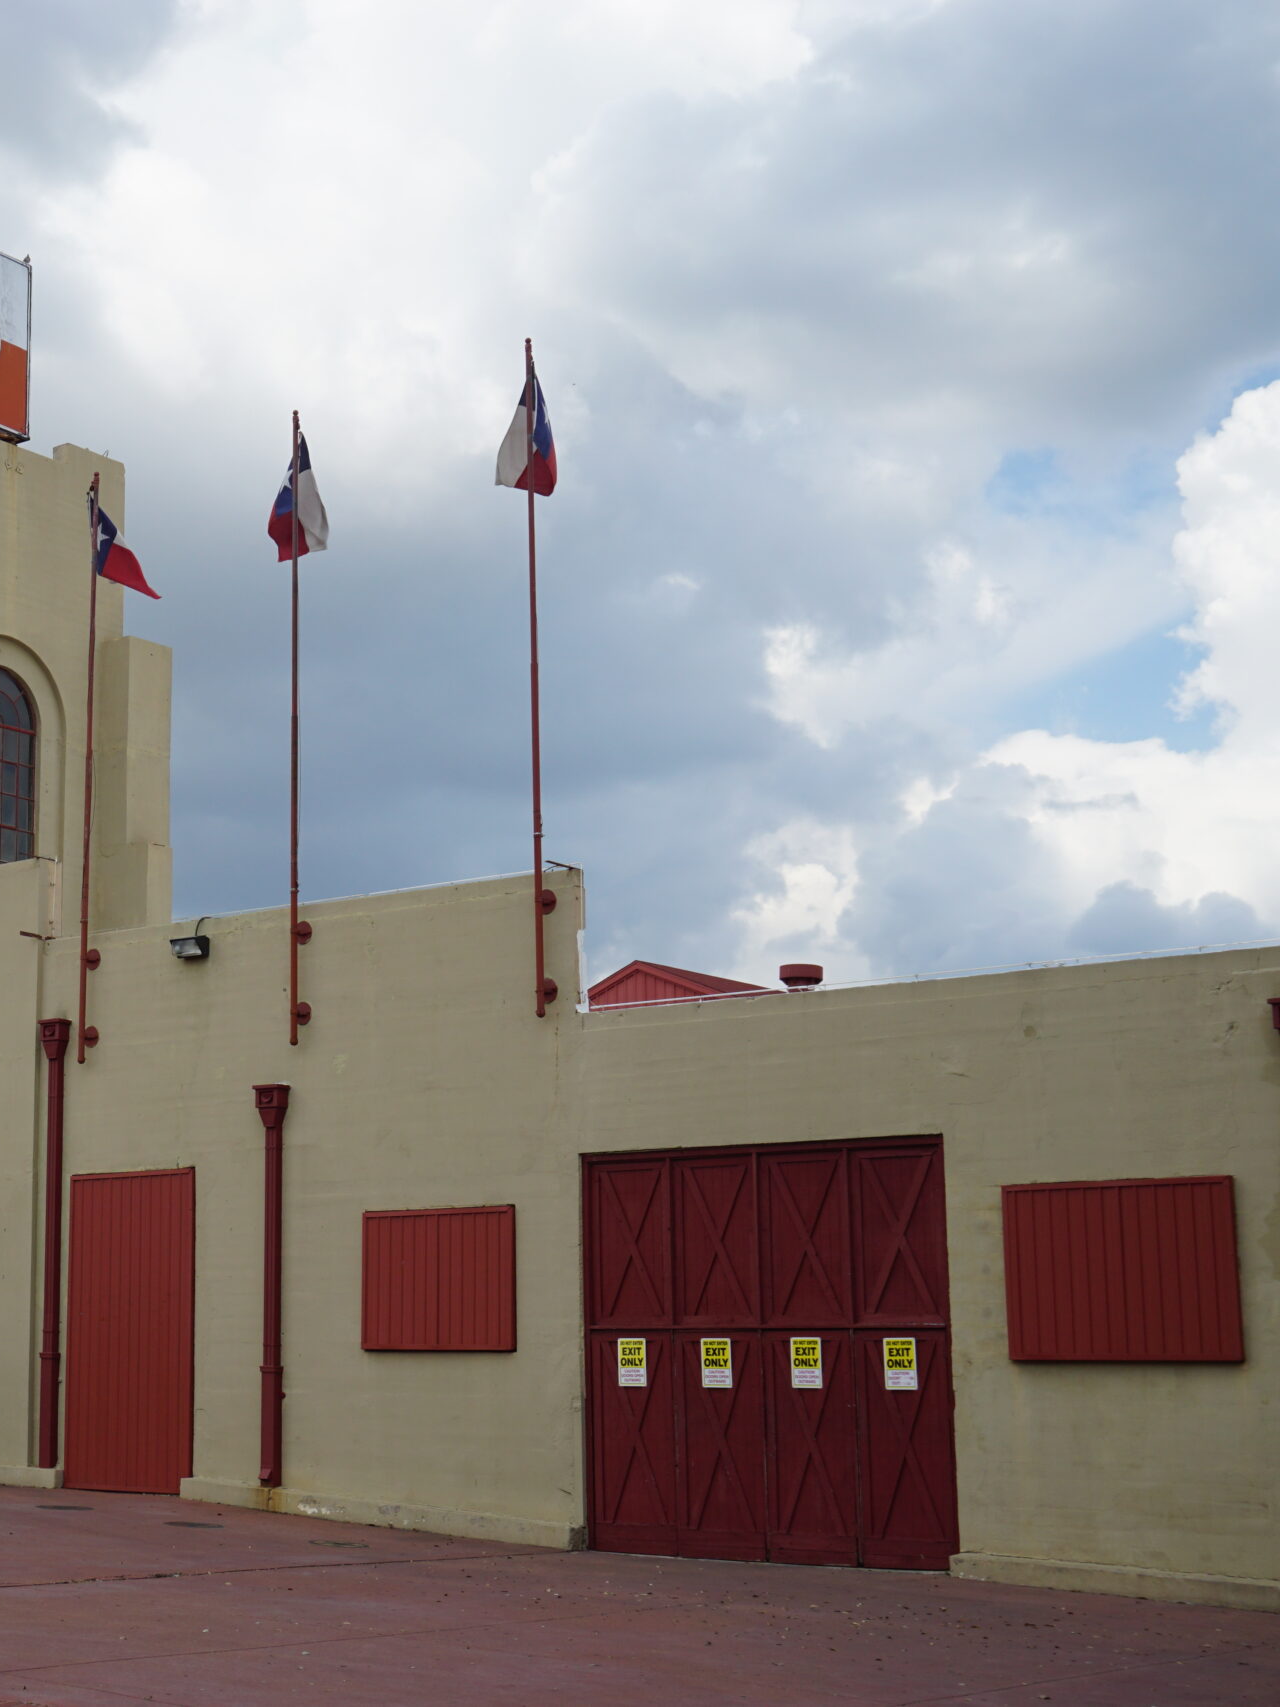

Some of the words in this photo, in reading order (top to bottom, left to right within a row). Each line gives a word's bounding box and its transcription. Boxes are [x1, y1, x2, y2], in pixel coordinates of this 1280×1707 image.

[622, 1347, 641, 1356] EXIT
[705, 1347, 726, 1356] EXIT
[795, 1347, 816, 1356] EXIT
[888, 1347, 910, 1357] EXIT
[620, 1357, 643, 1367] ONLY
[704, 1358, 728, 1367] ONLY
[794, 1358, 818, 1367] ONLY
[887, 1358, 913, 1368] ONLY
